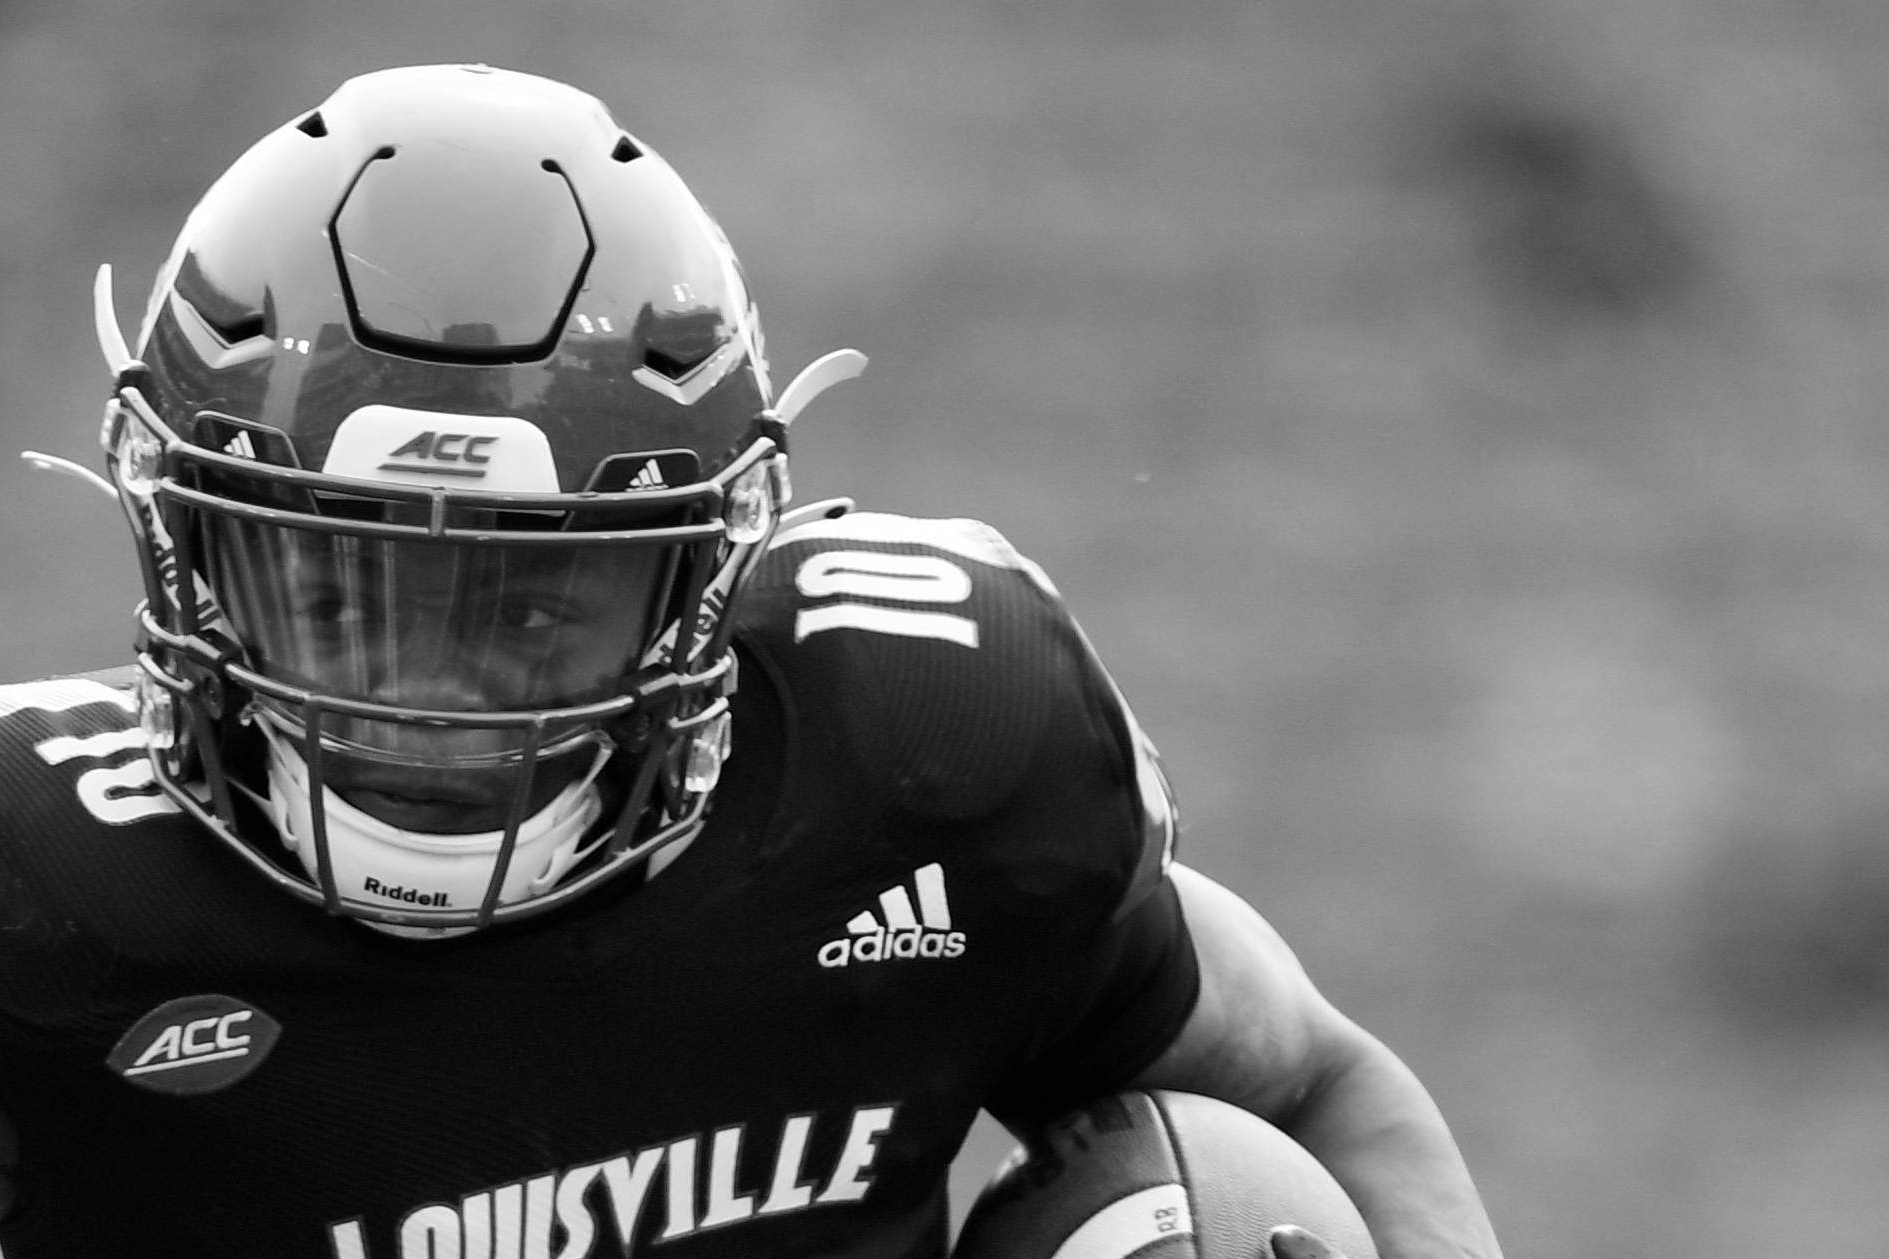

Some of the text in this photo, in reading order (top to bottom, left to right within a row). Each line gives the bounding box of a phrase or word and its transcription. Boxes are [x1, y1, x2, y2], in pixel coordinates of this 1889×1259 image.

[388, 431, 501, 463] ACC
[794, 550, 981, 650] 10
[363, 875, 449, 908] Riddell
[817, 923, 967, 968] adidas
[133, 1009, 254, 1067] ACC
